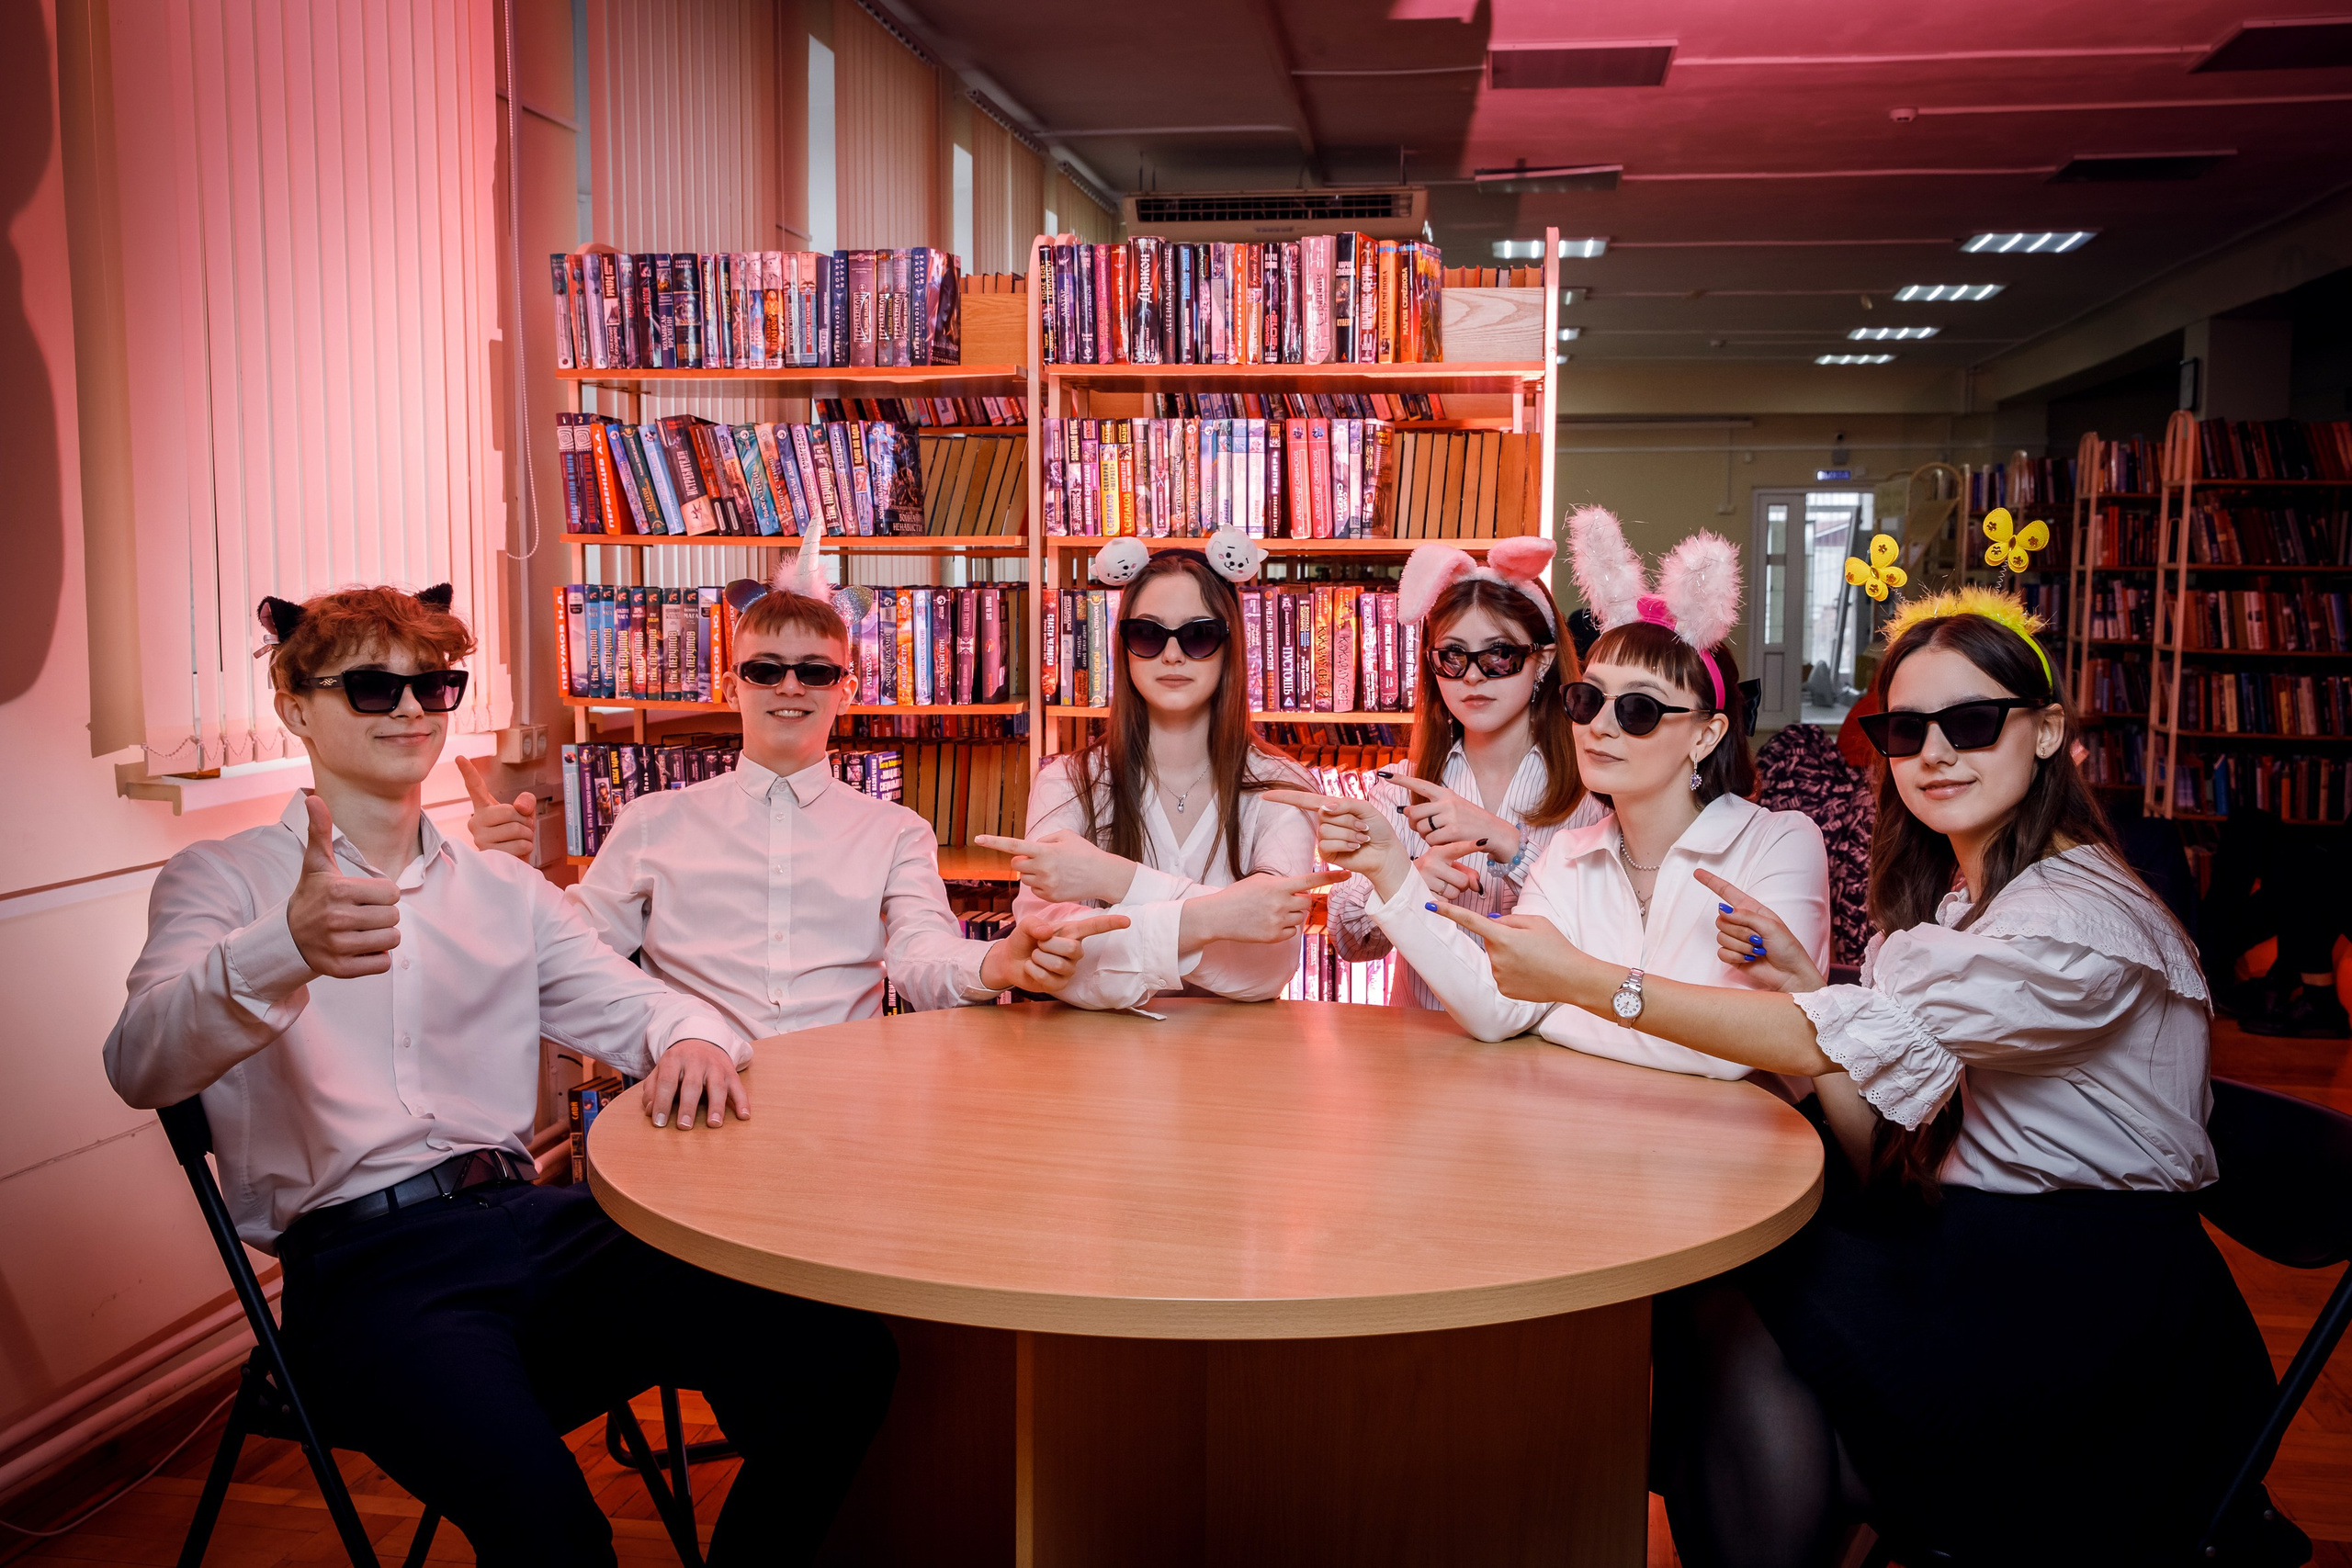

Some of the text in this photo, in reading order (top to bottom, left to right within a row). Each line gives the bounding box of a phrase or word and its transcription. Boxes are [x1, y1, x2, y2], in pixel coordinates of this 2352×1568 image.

[1137, 254, 1152, 303] Дракон
[1238, 249, 1241, 267] М.
[1362, 265, 1373, 292] ФЕРМИ
[878, 293, 888, 340] ГЕРМЕТИКОН
[894, 293, 904, 339] ГЕРМЕТИКОН
[1317, 274, 1325, 326] Странник
[1362, 294, 1373, 330] ПАРАДОКС
[583, 454, 592, 472] МАГИ
[768, 456, 779, 482] ТЕНЯМИ
[786, 460, 795, 477] ДУШ
[795, 429, 809, 469] АРМАГЕДДОН
[832, 428, 845, 469] АРМАГЕДДОН
[594, 429, 615, 528] ПЕРВЕНЦЕВ А.А.
[678, 450, 698, 496] ИСТРЕБИТЕЛИ
[752, 471, 770, 518] ВЬЮГА ТЕНЕЙ
[818, 468, 834, 504] ПЕРУМОВ
[569, 481, 579, 524] ВЛАСТИТЕЛИ
[586, 480, 596, 524] ВЛАСТИТЕЛИ
[778, 489, 789, 517] ДЖАНГА
[1123, 493, 1131, 527] СЕРТАКОВ
[559, 624, 568, 690] ПЕРУМОВ
[590, 629, 599, 682] Ник ПЕРУМОВ
[604, 627, 614, 664] ПЕРУМОВ
[617, 630, 630, 682] Ник ПЕРУМОВ
[634, 631, 645, 684] Ник ПЕРУМОВ
[649, 629, 659, 682] Ник ПЕРУМОВ
[668, 630, 679, 683] Ник ПЕРУМОВ
[686, 631, 697, 683] Ник ПЕРУМОВ
[1046, 614, 1055, 666] СПАСТИ ЧЕЛОВЕКА
[1266, 633, 1274, 671] ВОСКРЕШАЯ
[1317, 626, 1329, 667] КАЖДОМУ
[1282, 646, 1294, 695] ПУСТОШЬ
[1335, 636, 1350, 705] КАЖДОМУ СВОЕ
[1317, 690, 1329, 698] 2
[570, 1101, 579, 1120] СЛОЙ
